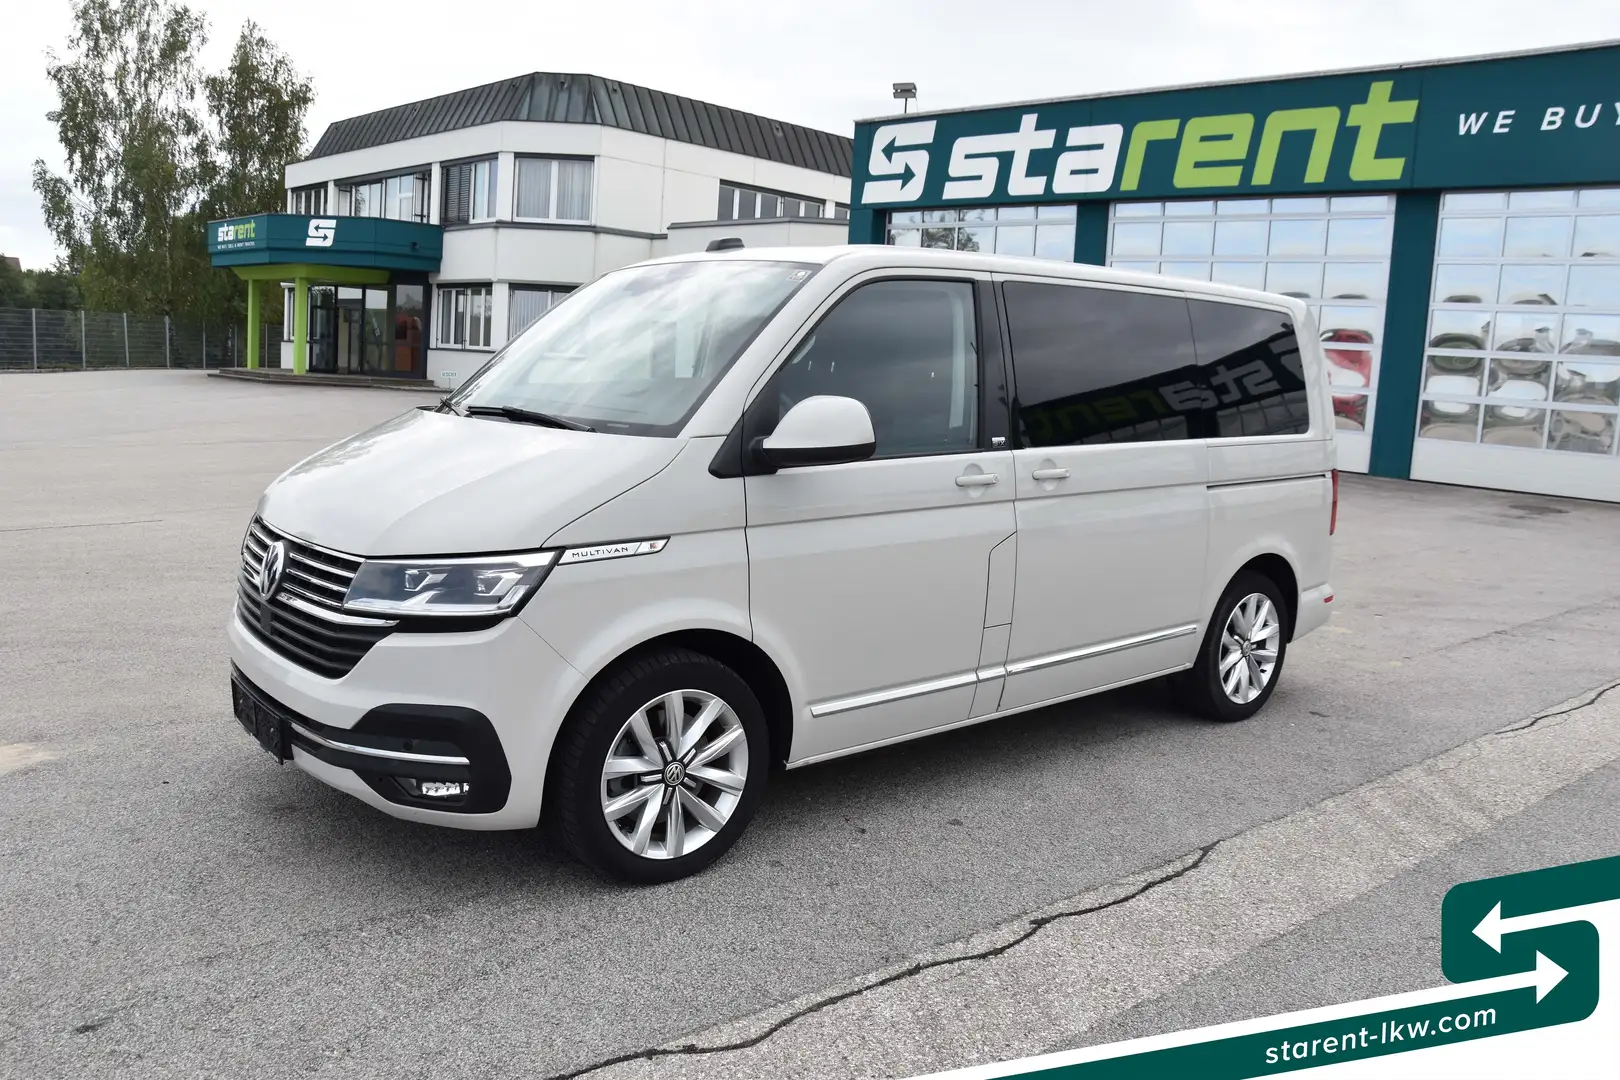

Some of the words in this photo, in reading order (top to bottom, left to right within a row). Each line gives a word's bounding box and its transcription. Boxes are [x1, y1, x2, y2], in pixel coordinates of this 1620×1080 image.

[1458, 109, 1517, 136] WE
[942, 80, 1419, 200] starent
[217, 219, 256, 242] starent
[571, 546, 629, 559] MULTIVAN
